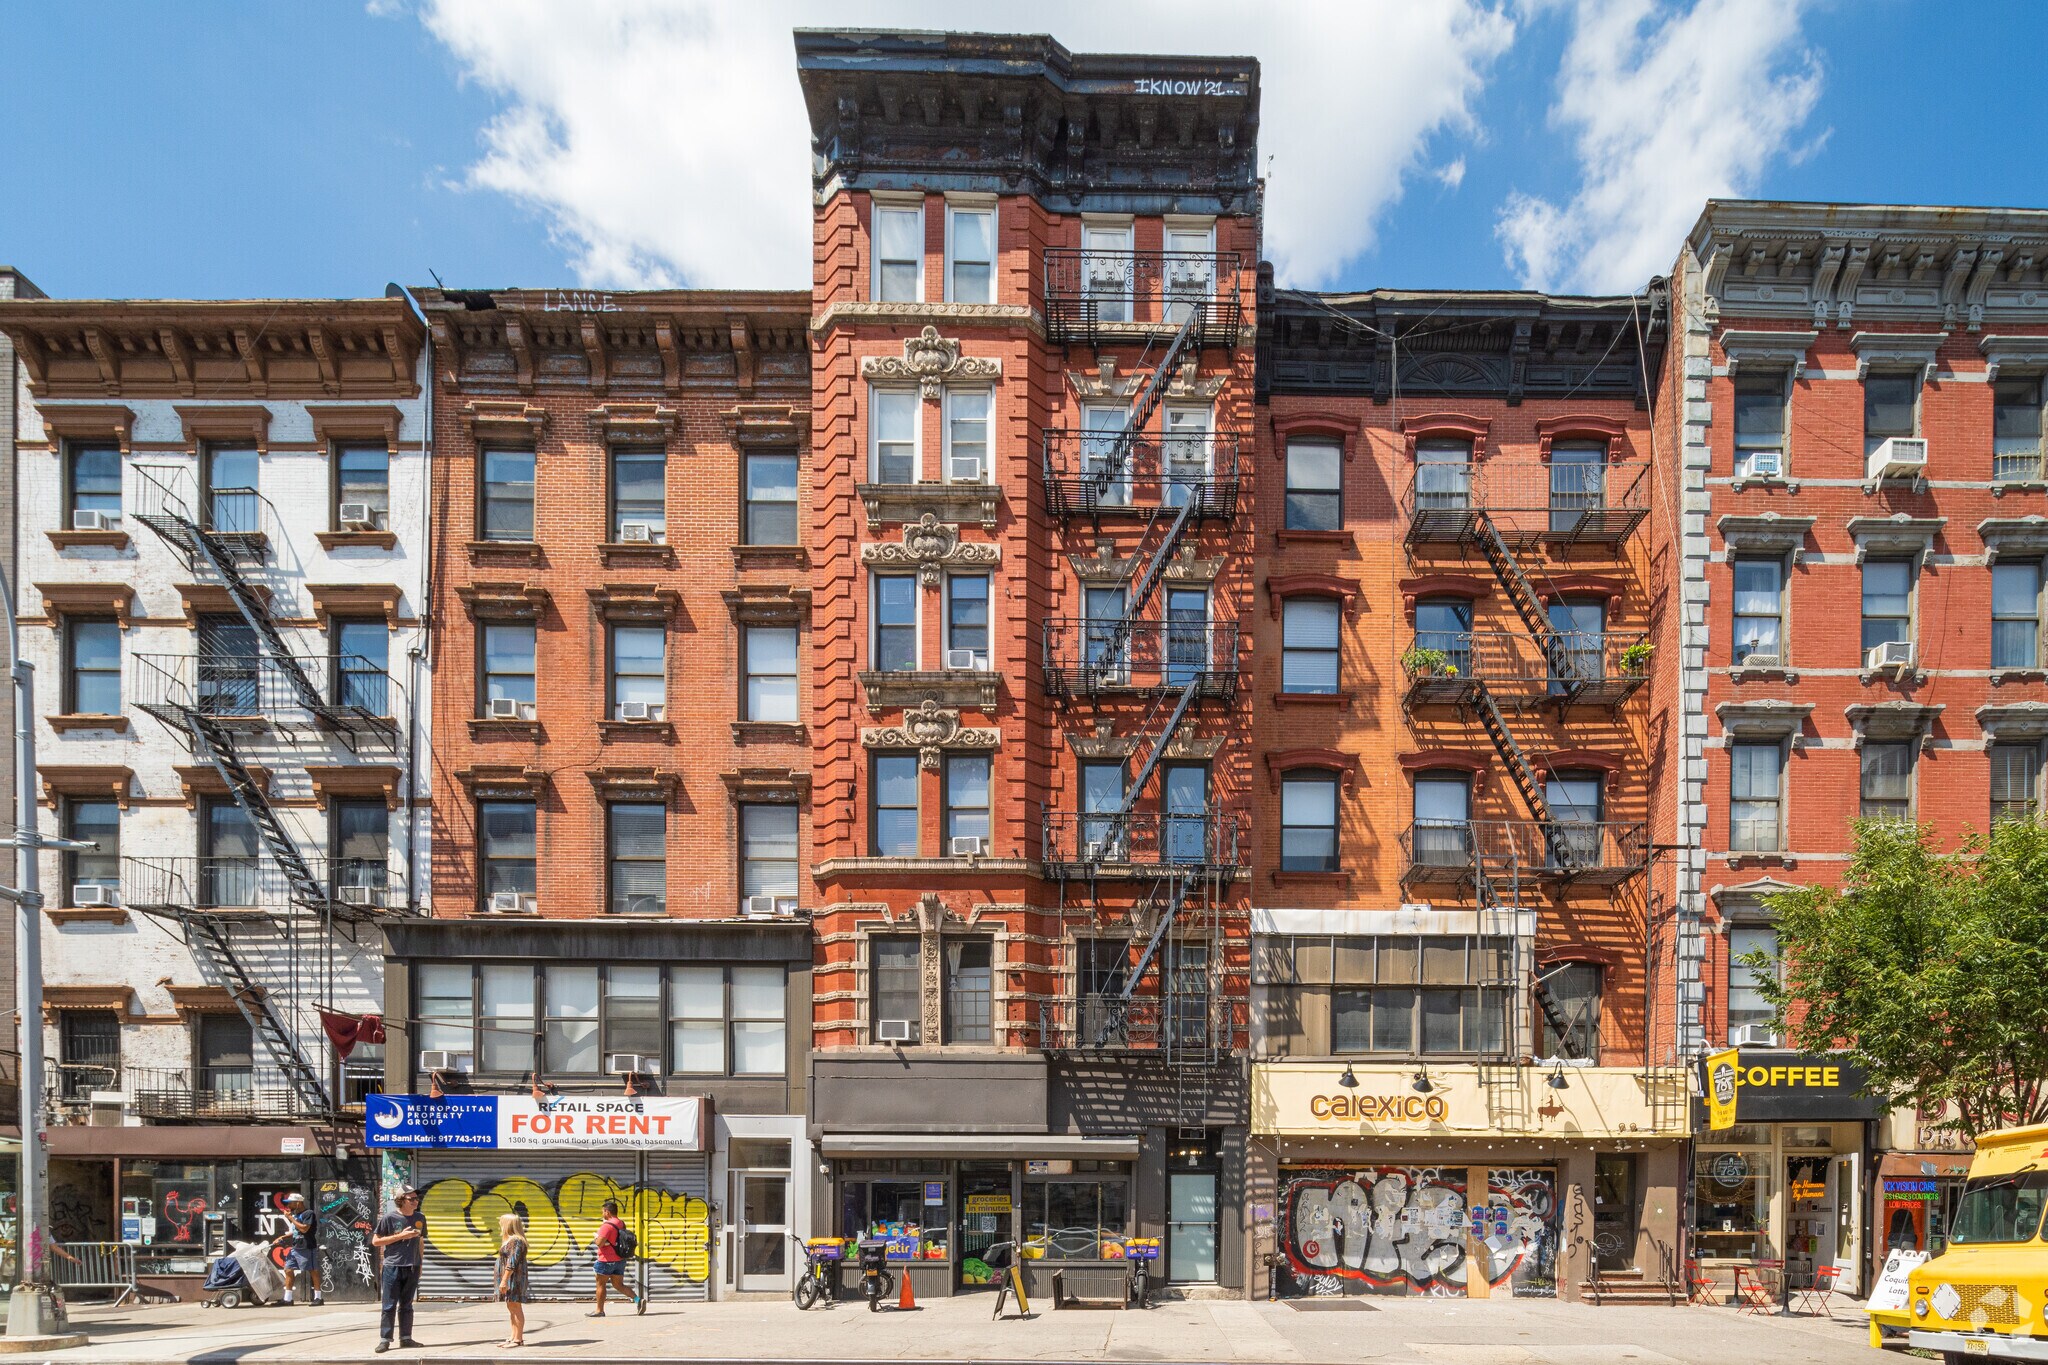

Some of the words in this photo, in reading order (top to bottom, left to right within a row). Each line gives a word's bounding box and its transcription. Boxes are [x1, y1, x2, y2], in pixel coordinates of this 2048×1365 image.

[538, 1102, 591, 1112] RETAIL
[596, 1103, 644, 1113] SPACE
[511, 1114, 574, 1134] FOR
[586, 1115, 671, 1135] RENT
[373, 1134, 390, 1142] Call
[391, 1134, 412, 1142] Sami
[455, 1135, 491, 1143] 743-1713
[591, 1138, 608, 1146] plus
[630, 1138, 643, 1146] sq.
[645, 1138, 683, 1146] basement
[1918, 1181, 1937, 1191] CARE
[1884, 1275, 1909, 1285] Coquit
[1888, 1287, 1908, 1296] Latte
